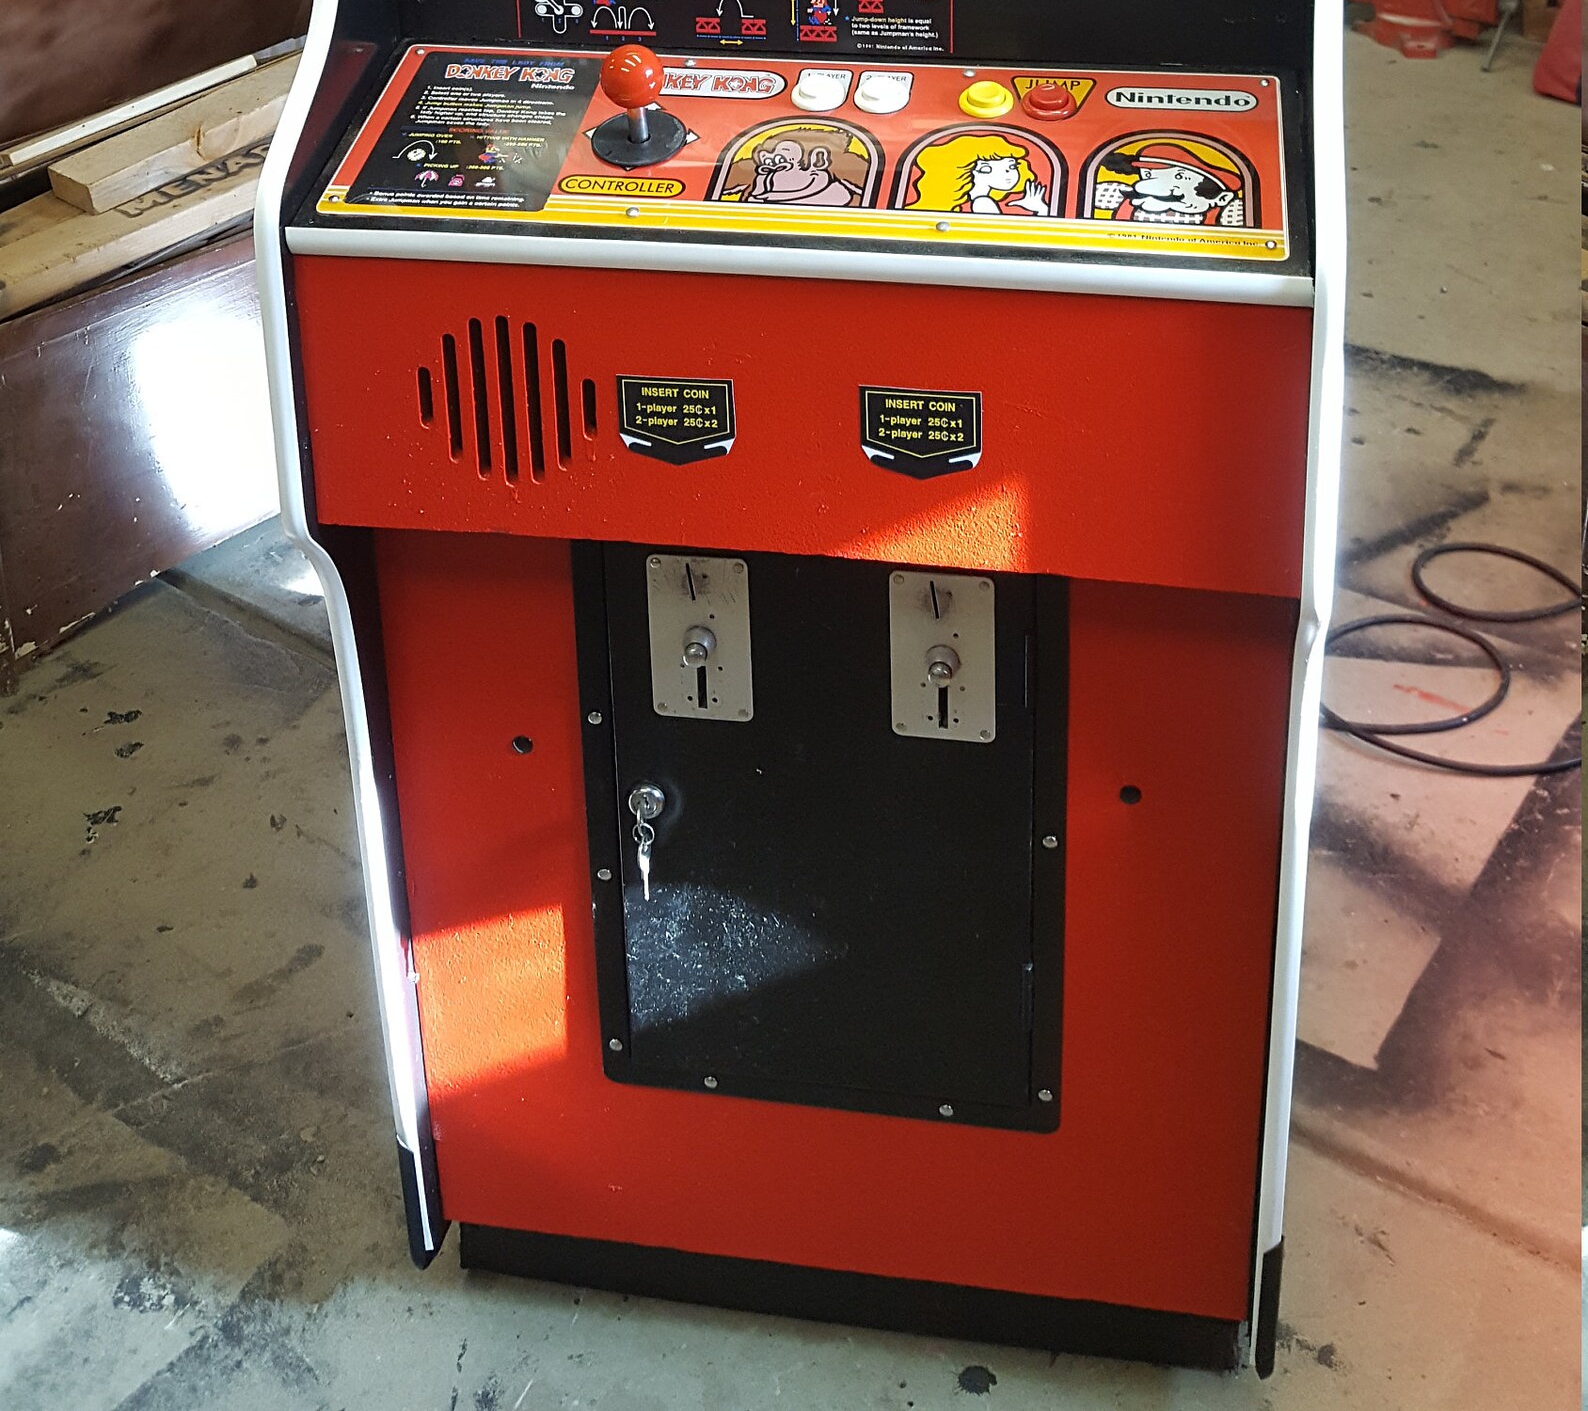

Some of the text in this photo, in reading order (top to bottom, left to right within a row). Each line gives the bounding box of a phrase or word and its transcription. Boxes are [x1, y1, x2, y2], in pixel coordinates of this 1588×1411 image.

[445, 64, 575, 84] DONKEY KONG
[665, 72, 776, 94] KEY KONG
[1114, 89, 1252, 107] Nintendo
[565, 179, 674, 193] CONTROLLER
[641, 386, 709, 400] INSERT COIN
[636, 403, 677, 415] 1-player
[885, 398, 956, 412] INSERT COIN
[635, 416, 678, 428] 2-player
[879, 414, 922, 427] 1-player
[878, 427, 922, 440] 2-player
